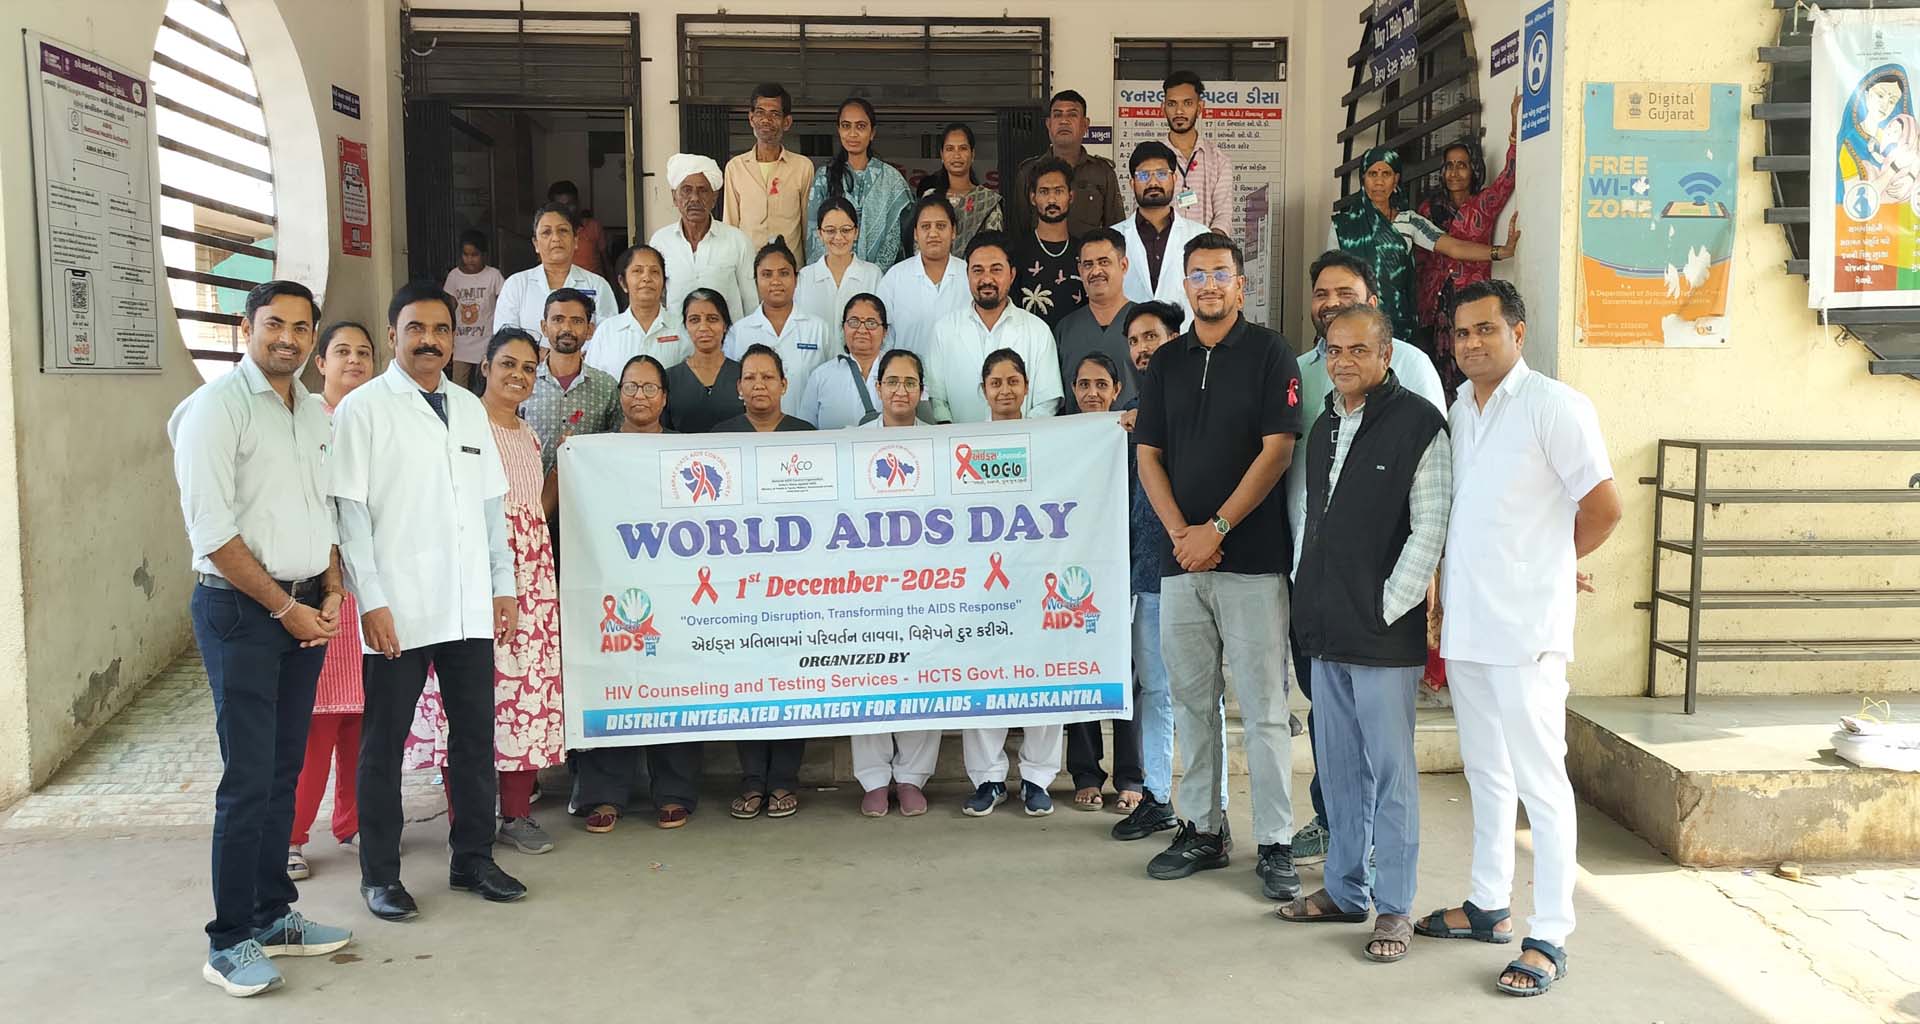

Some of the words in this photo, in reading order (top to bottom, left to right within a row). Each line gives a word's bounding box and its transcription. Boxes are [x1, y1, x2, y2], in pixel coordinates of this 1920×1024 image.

[1374, 27, 1386, 50] May
[1389, 13, 1403, 39] Help
[1246, 86, 1280, 104] ડીસા
[1648, 92, 1694, 107] Digital
[1648, 107, 1695, 122] Gujarat
[1589, 155, 1649, 175] FREE
[980, 461, 1023, 478] ૧૦૯૭
[616, 514, 813, 560] WORLD
[825, 508, 954, 550] AIDS
[967, 501, 1078, 543] DAY
[736, 571, 761, 599] 1st
[765, 566, 967, 598] December-2025
[680, 612, 758, 626] "Overcoming
[761, 609, 825, 624] Disruption,
[827, 604, 904, 619] Transforming
[907, 604, 925, 615] the
[927, 602, 956, 614] AIDS
[959, 599, 1022, 614] Response"
[1042, 611, 1085, 630] AIDS
[601, 633, 645, 653] AIDS
[739, 630, 803, 649] પ્રતિભાવમાં
[806, 628, 858, 647] પરિવર્તન
[909, 623, 953, 642] વિક્ષેપને
[955, 627, 973, 643] દુર
[976, 620, 1014, 638] કરીએ.
[799, 653, 886, 668] ORGANIZED
[887, 651, 911, 664] BY
[604, 685, 633, 701] HIV
[638, 680, 729, 699] Counseling
[733, 677, 764, 693] and
[768, 674, 826, 693] Testing
[831, 670, 898, 688] Services
[917, 668, 962, 684] HCTS
[967, 666, 1009, 681] Govt.
[1013, 664, 1040, 679] Ho.
[1045, 660, 1101, 677] DEESA
[605, 710, 677, 731] DISTRICT
[681, 704, 780, 727] INTEGRATED
[783, 700, 863, 721] STRATEGY
[865, 699, 896, 717] FOR
[900, 694, 972, 714] HIV/AIDS
[985, 688, 1103, 711] BANASKANTHA
